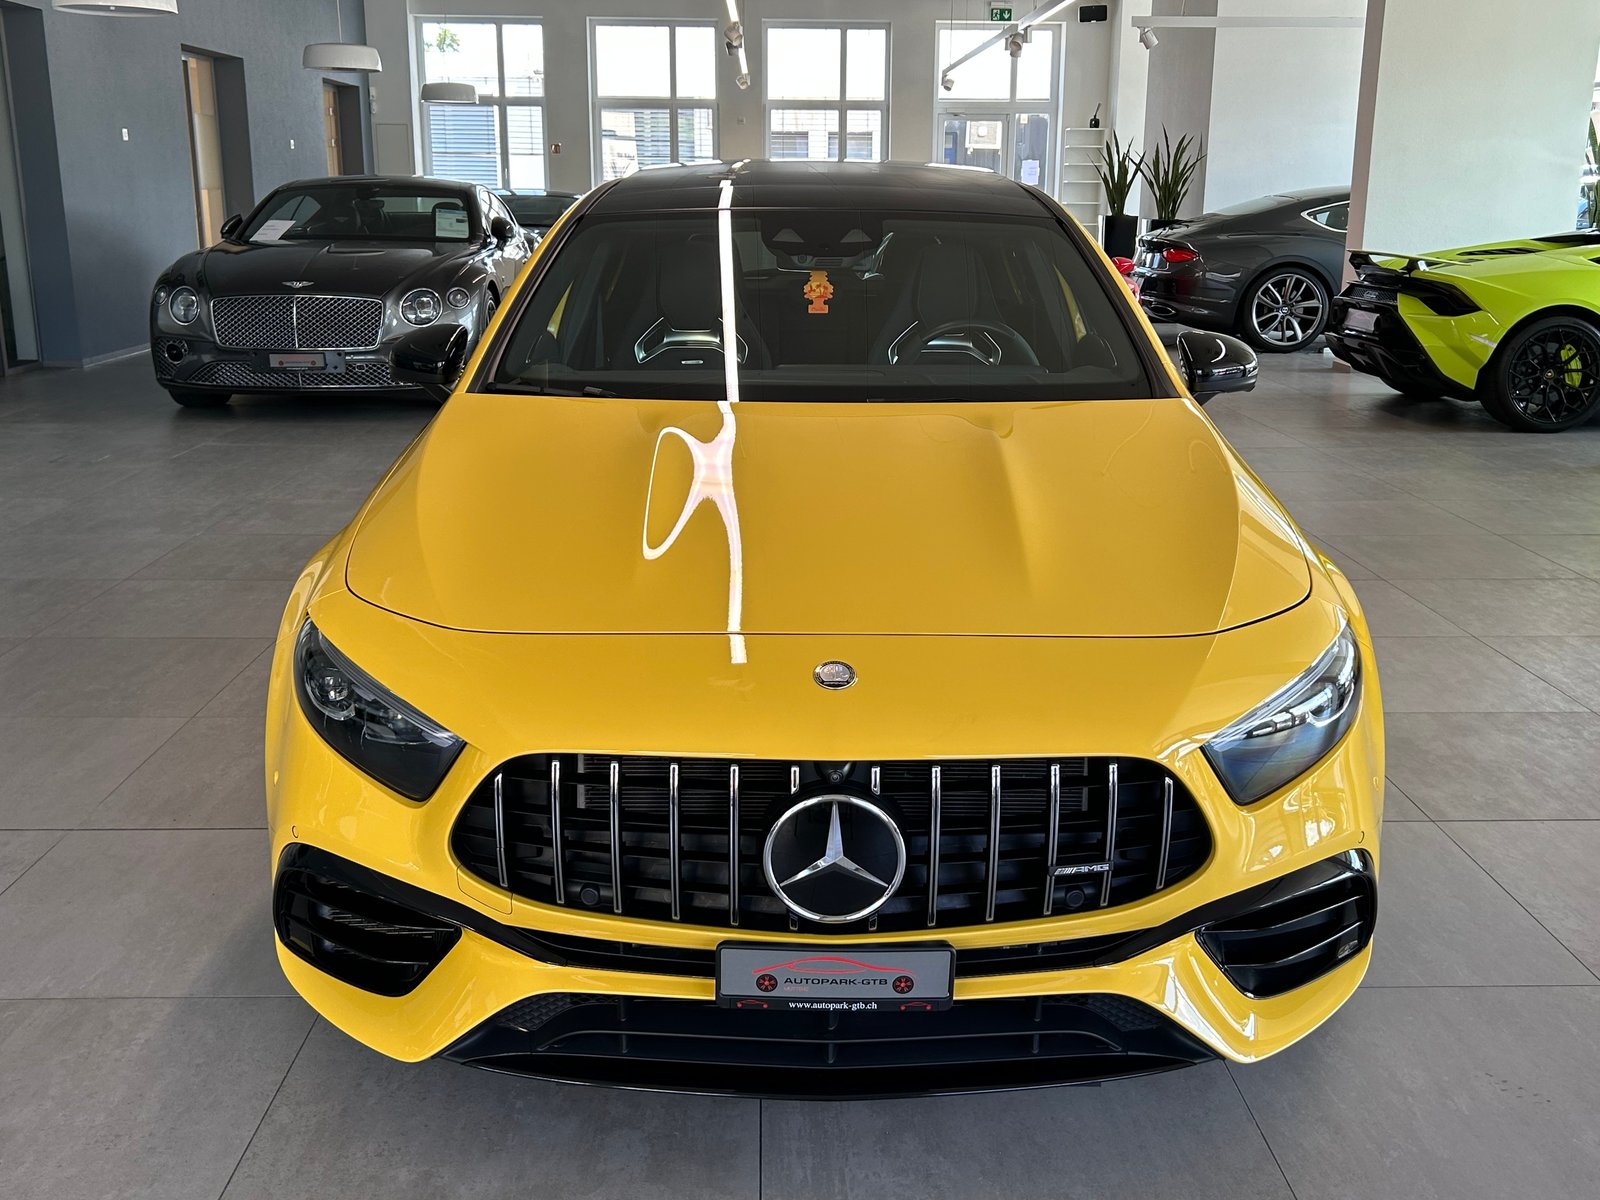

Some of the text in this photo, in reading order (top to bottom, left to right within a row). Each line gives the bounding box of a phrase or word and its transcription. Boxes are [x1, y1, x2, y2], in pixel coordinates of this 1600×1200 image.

[1071, 863, 1109, 874] AMG
[784, 977, 888, 986] AUTOPARK-GTB
[788, 1001, 878, 1011] www.autopark-gtb.ch
